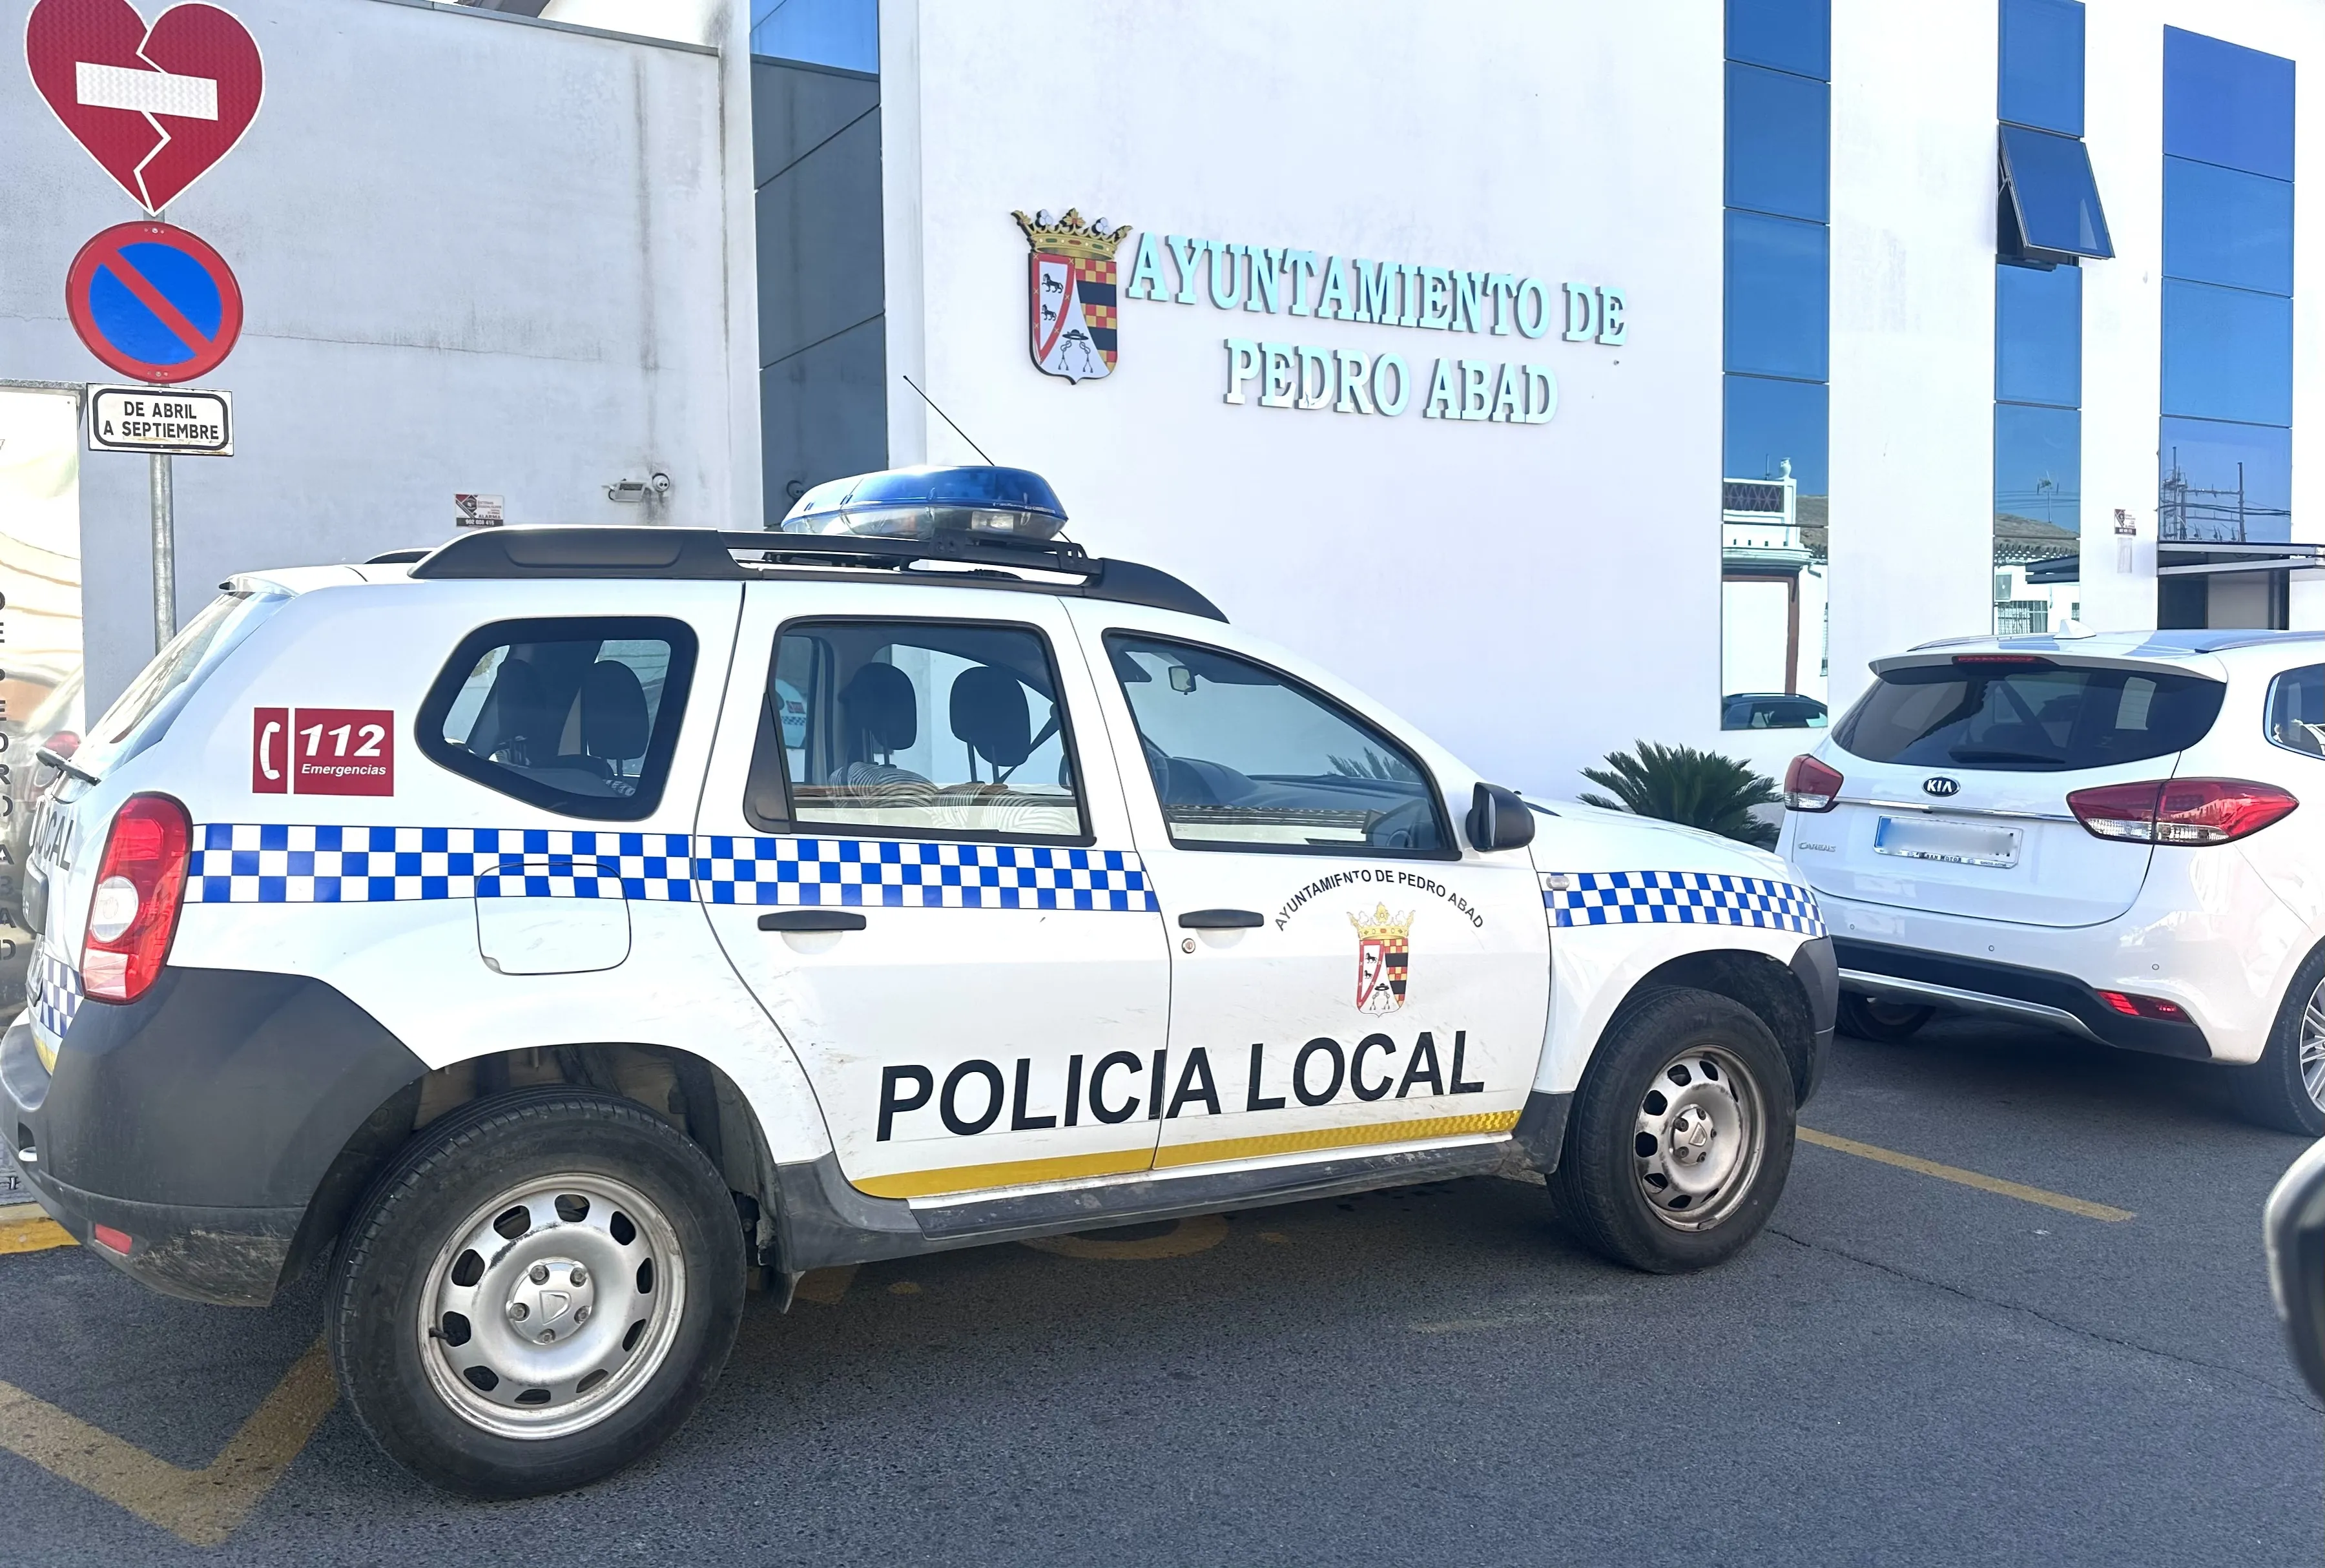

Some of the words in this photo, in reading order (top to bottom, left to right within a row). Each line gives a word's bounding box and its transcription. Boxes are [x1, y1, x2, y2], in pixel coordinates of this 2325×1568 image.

[1126, 232, 1551, 338] AYUNTAMIENTO
[1562, 282, 1628, 346] DE
[1223, 338, 1410, 417] PEDRO
[1423, 358, 1558, 424] ABAD
[123, 401, 145, 417] DE
[152, 403, 196, 418] ABRIL
[103, 420, 114, 435] A
[122, 421, 219, 439] SEPTIEMBRE
[300, 724, 385, 756] 112
[302, 763, 386, 777] Emergencias
[1927, 779, 1952, 792] KIA
[1375, 870, 1394, 882] DE
[1398, 872, 1446, 897] PEDRO
[1447, 892, 1483, 928] ABAD
[876, 1047, 1221, 1142] POLICIA
[1246, 1029, 1485, 1112] LOCAL
